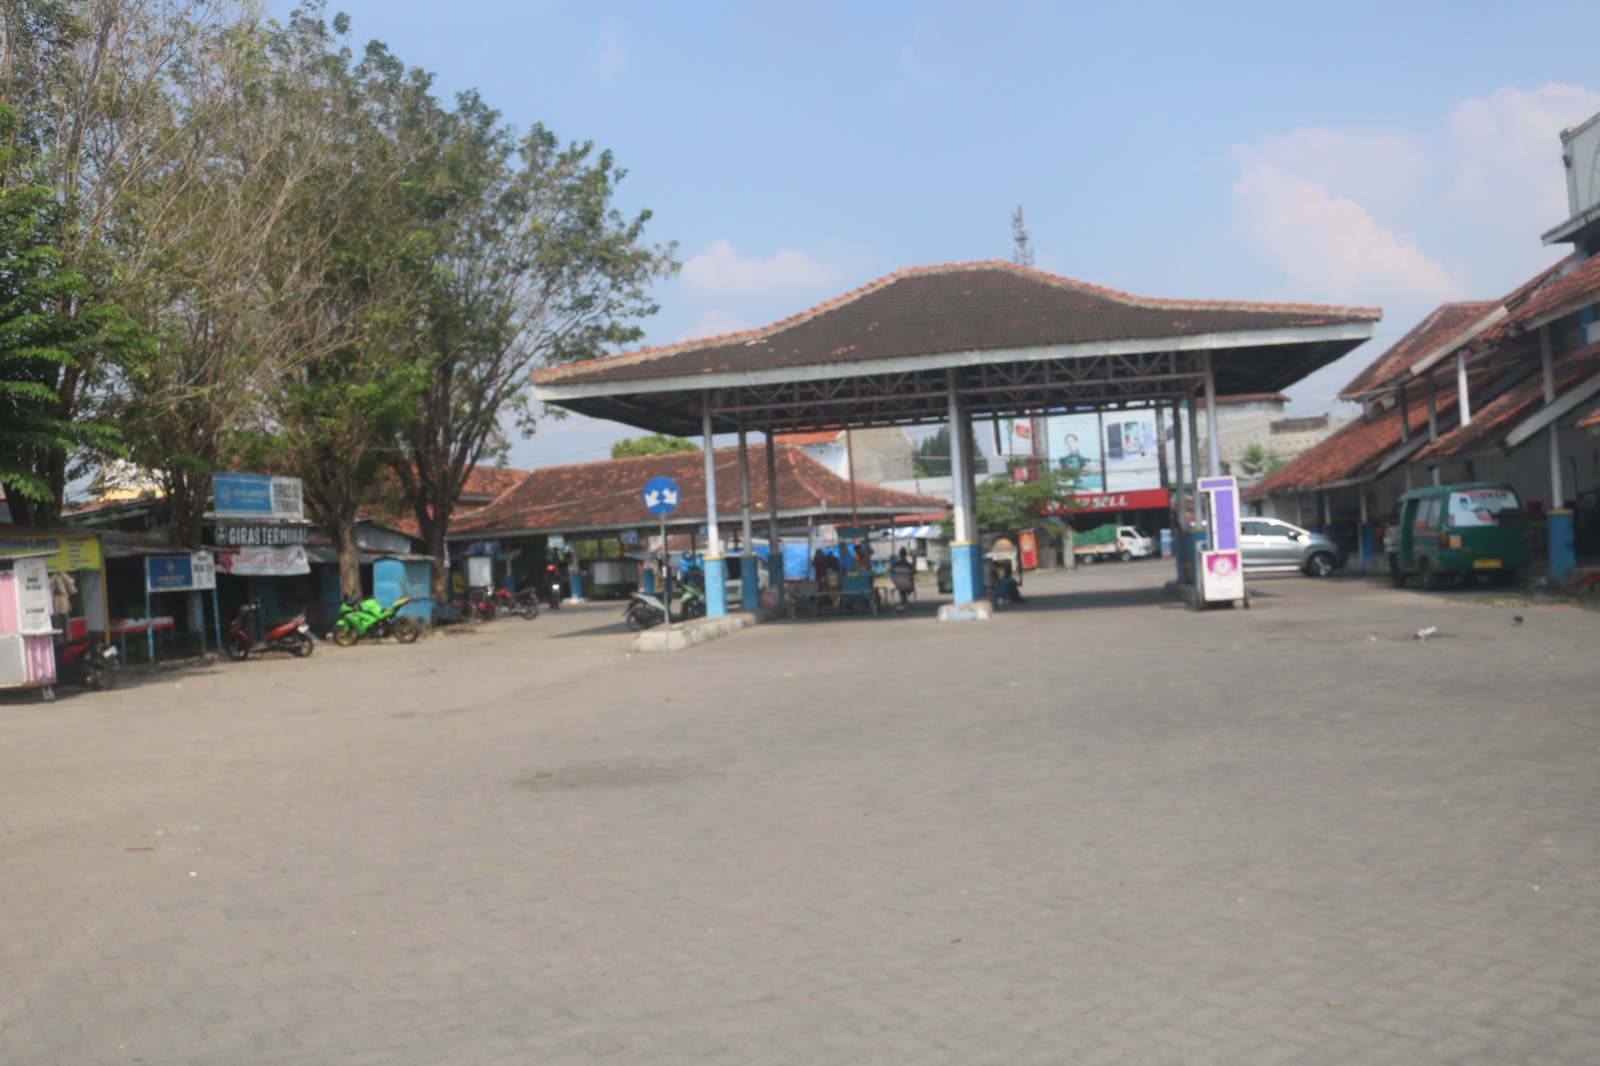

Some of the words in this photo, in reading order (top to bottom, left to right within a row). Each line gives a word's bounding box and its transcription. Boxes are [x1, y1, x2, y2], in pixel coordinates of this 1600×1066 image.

[273, 483, 291, 499] GIRAS
[1092, 496, 1128, 508] SELL
[229, 527, 260, 545] GIRAS
[261, 527, 309, 545] TERMINAL
